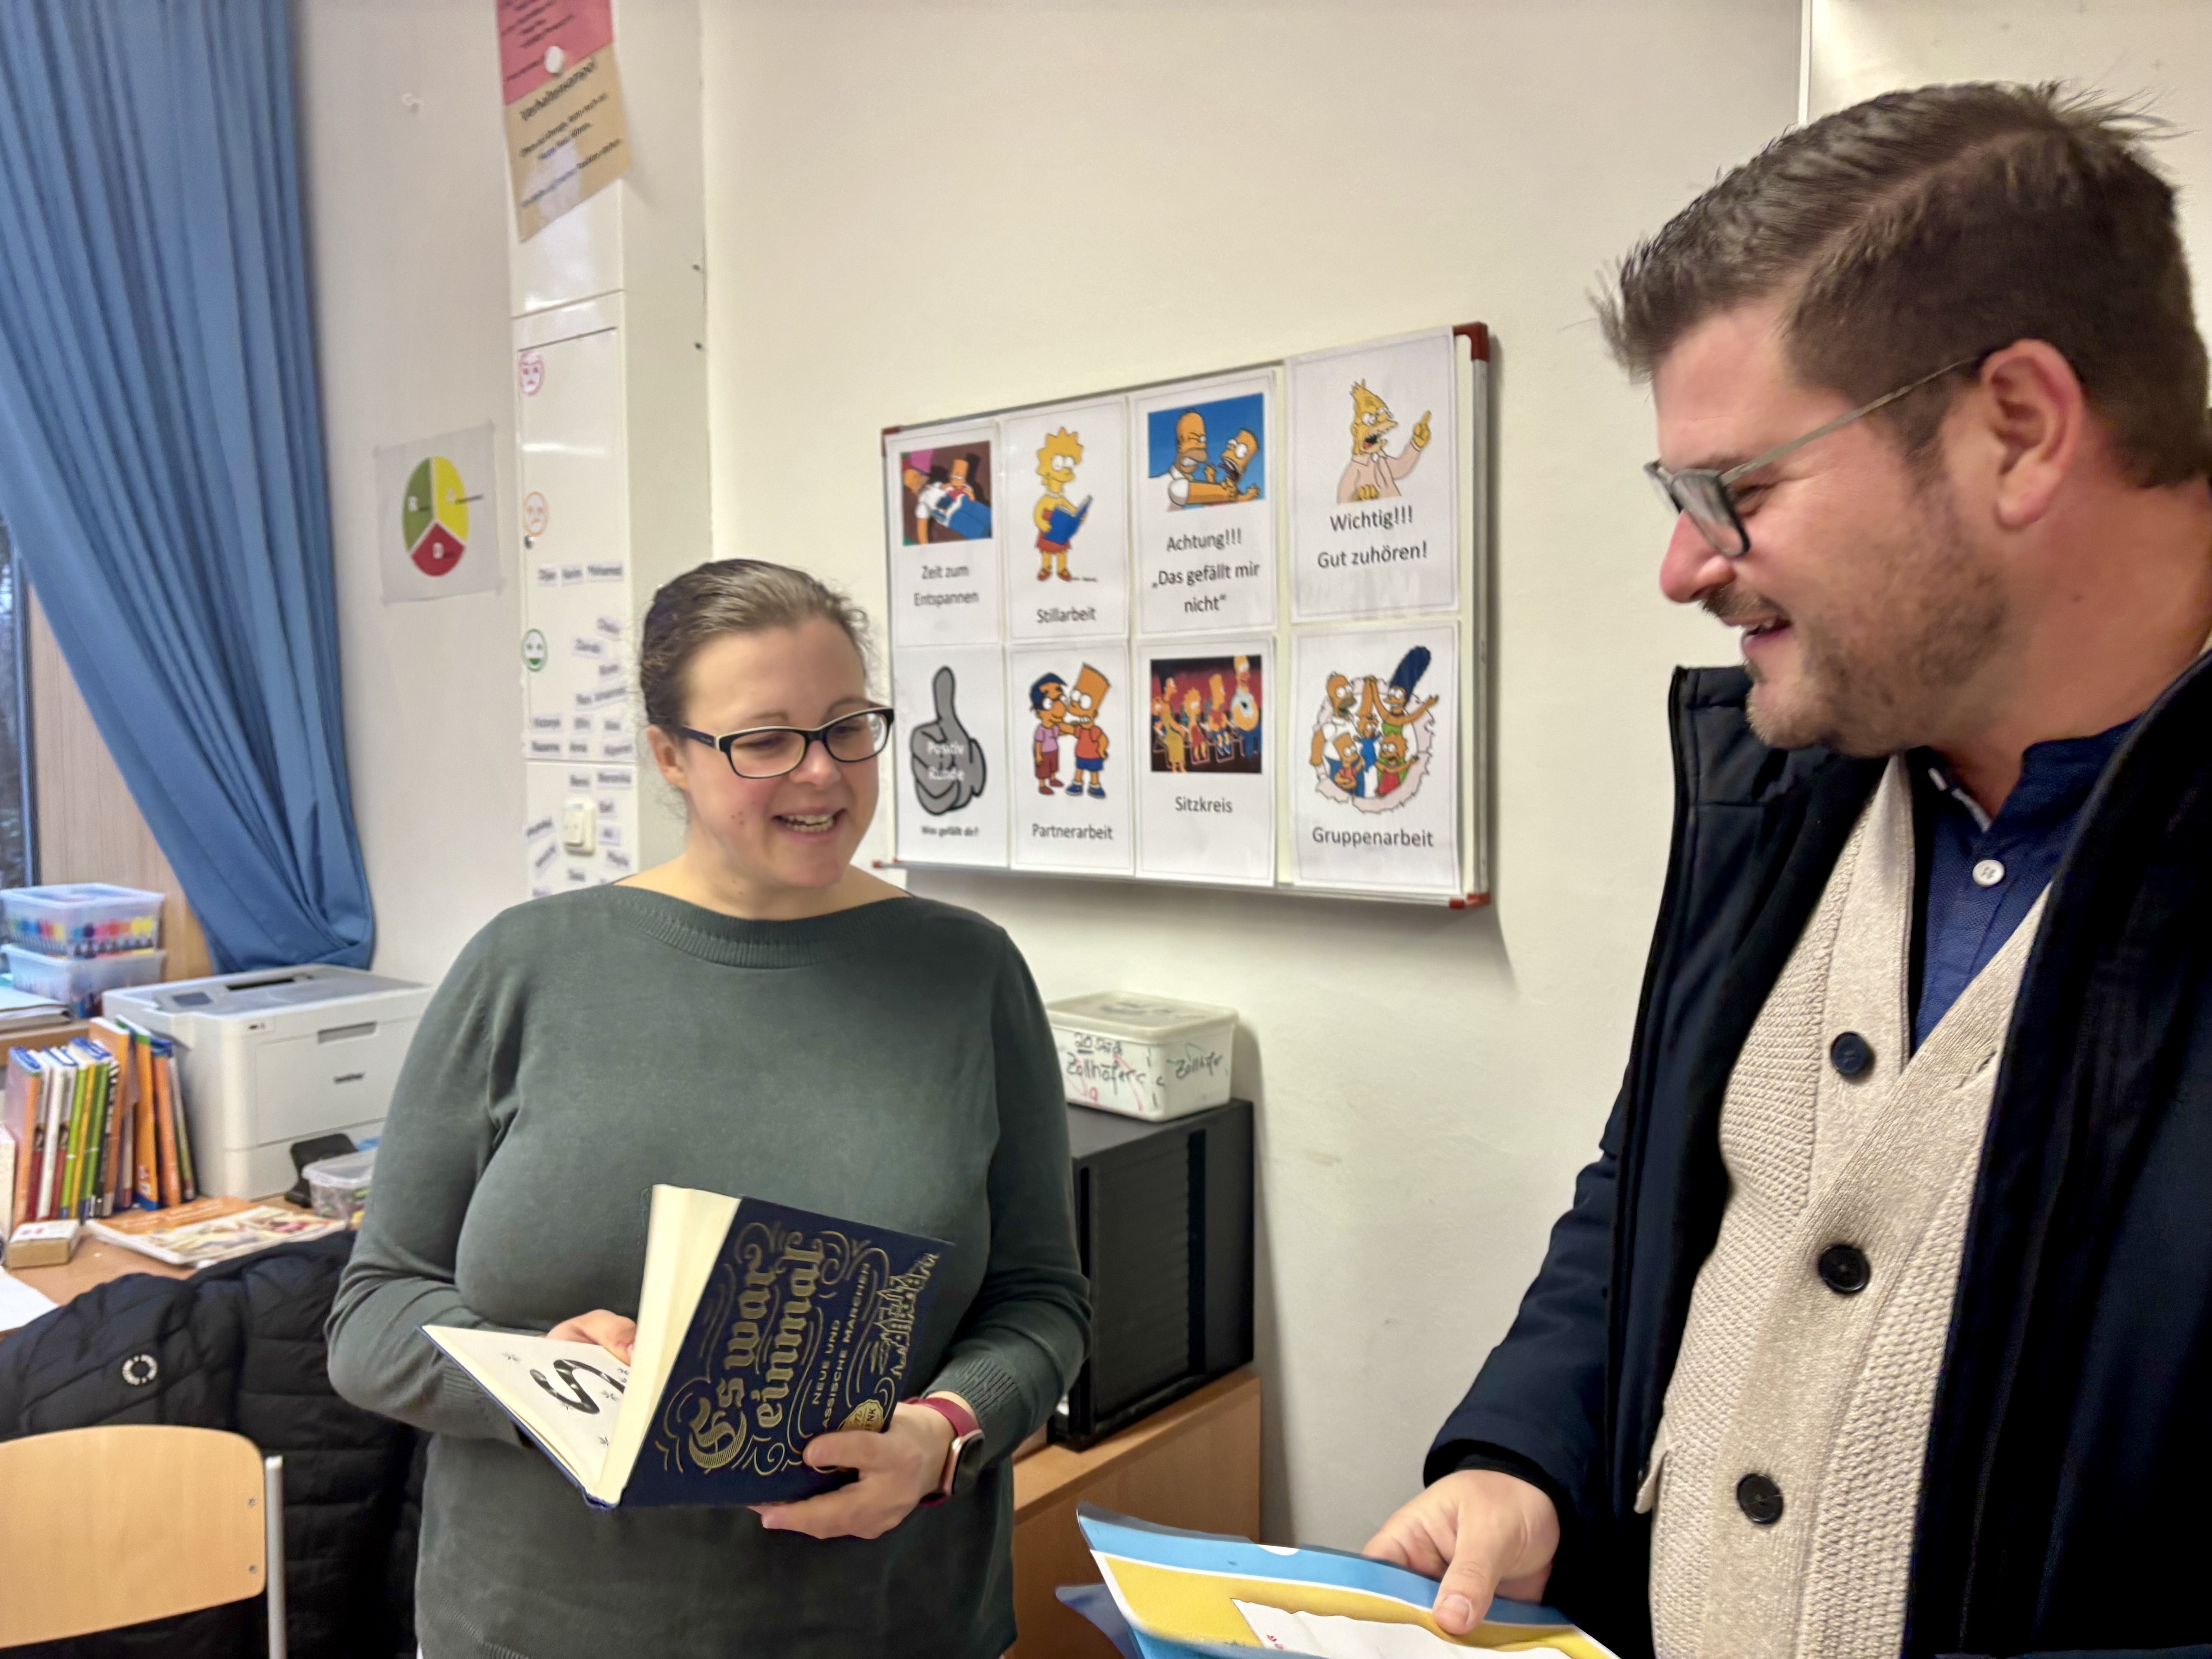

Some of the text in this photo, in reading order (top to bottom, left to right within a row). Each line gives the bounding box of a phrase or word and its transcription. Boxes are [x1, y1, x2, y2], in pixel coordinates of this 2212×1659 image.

[1330, 505, 1413, 532] Wichtig!!!
[1166, 527, 1242, 551] Achtung!!!
[1317, 540, 1427, 568] Gut zuhören!
[921, 565, 969, 579] Zeit zum
[1187, 564, 1231, 586] gefällt
[1235, 561, 1260, 578] mir
[914, 592, 980, 608] Entspannen
[1037, 606, 1096, 623] Stillarbeit
[1175, 796, 1233, 813] Sitzkreis
[1032, 823, 1113, 840] Partnerarbeit
[1312, 826, 1434, 848] Gruppenarbeit
[751, 1231, 827, 1428] einmal
[689, 1243, 781, 1470] Es war
[812, 1319, 840, 1405] NEUE UND
[822, 1349, 848, 1428] ASSISCHE
